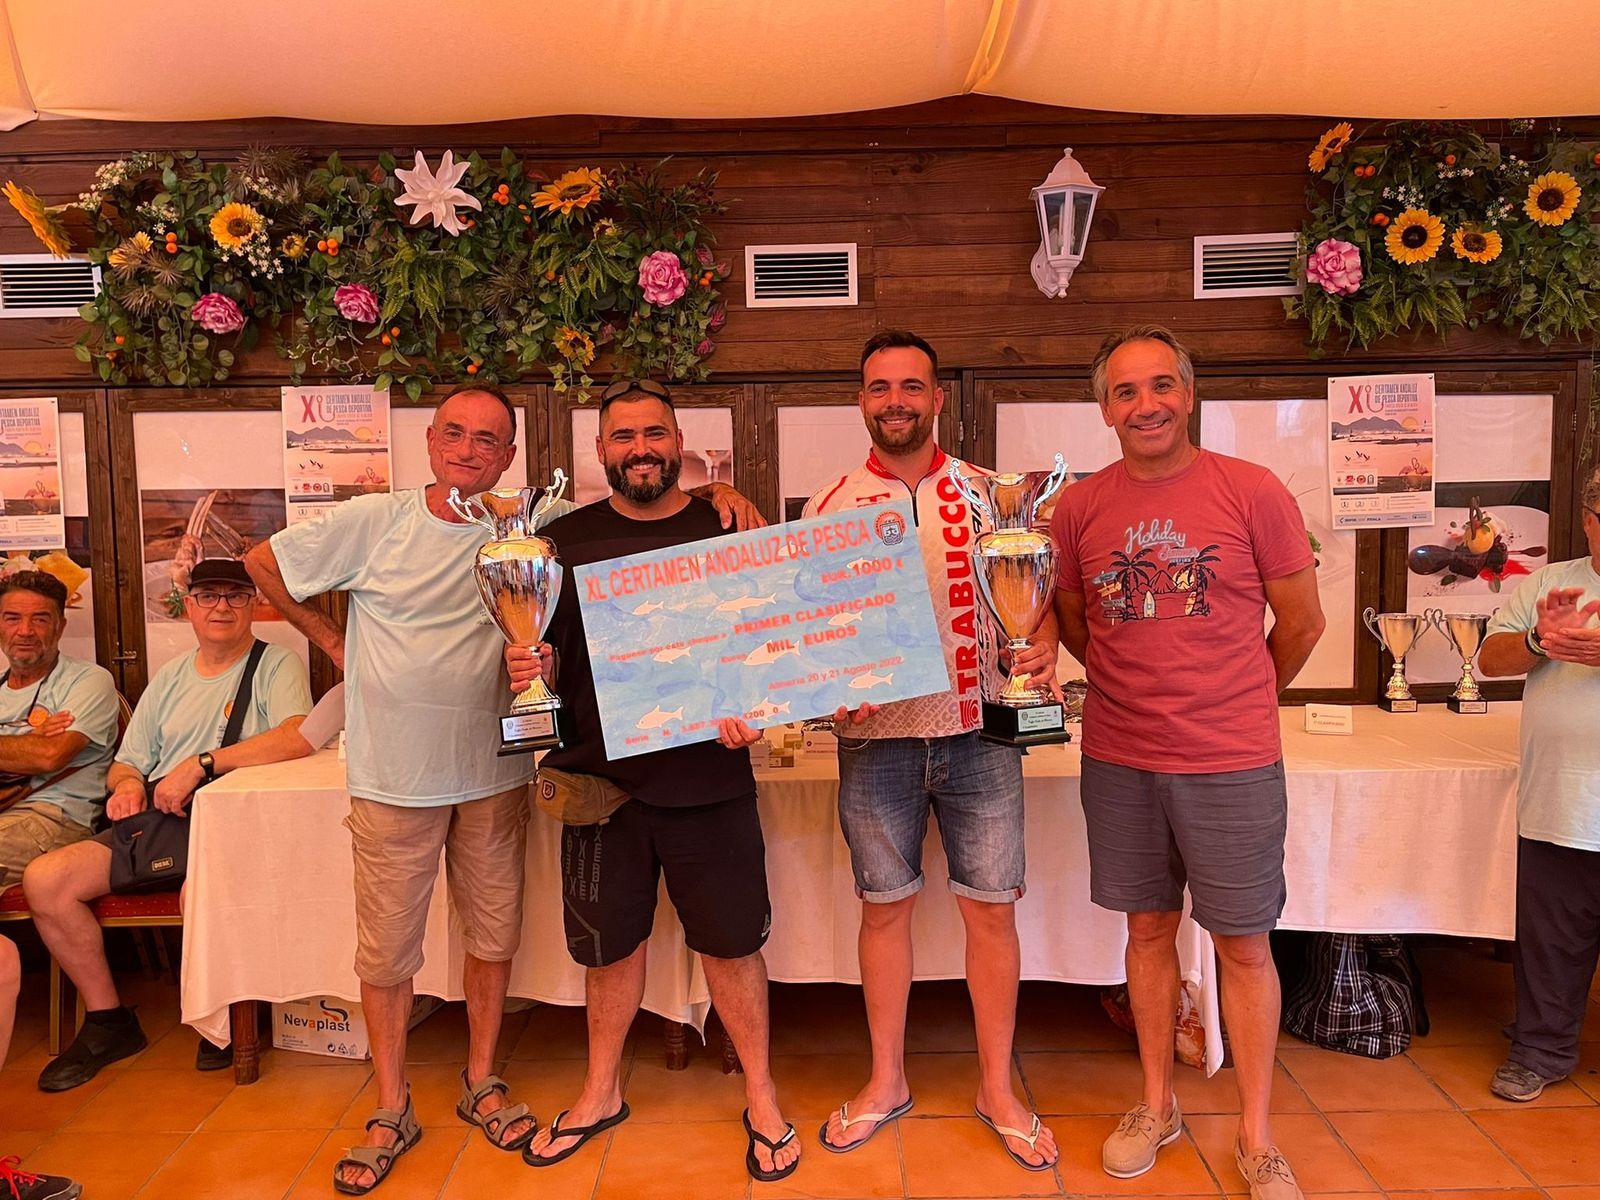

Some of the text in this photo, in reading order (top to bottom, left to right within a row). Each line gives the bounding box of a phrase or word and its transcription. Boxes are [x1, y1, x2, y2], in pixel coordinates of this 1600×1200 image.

[1125, 519, 1186, 554] Holiday
[585, 571, 609, 603] XL
[608, 553, 702, 597] CERTAMEN
[705, 536, 784, 577] ANDALUZ
[785, 530, 811, 559] DE
[811, 518, 873, 553] PESCA
[852, 556, 893, 577] 1000
[937, 476, 978, 695] TRABUCCO
[733, 612, 791, 636] PRIMER
[795, 591, 897, 623] CLASIFICADO
[766, 640, 795, 654] MIL
[802, 625, 859, 646] EUROS
[807, 672, 820, 683] 20
[828, 669, 840, 679] 21
[843, 662, 877, 677] Agosto
[283, 1013, 350, 1032] Nevaplast
